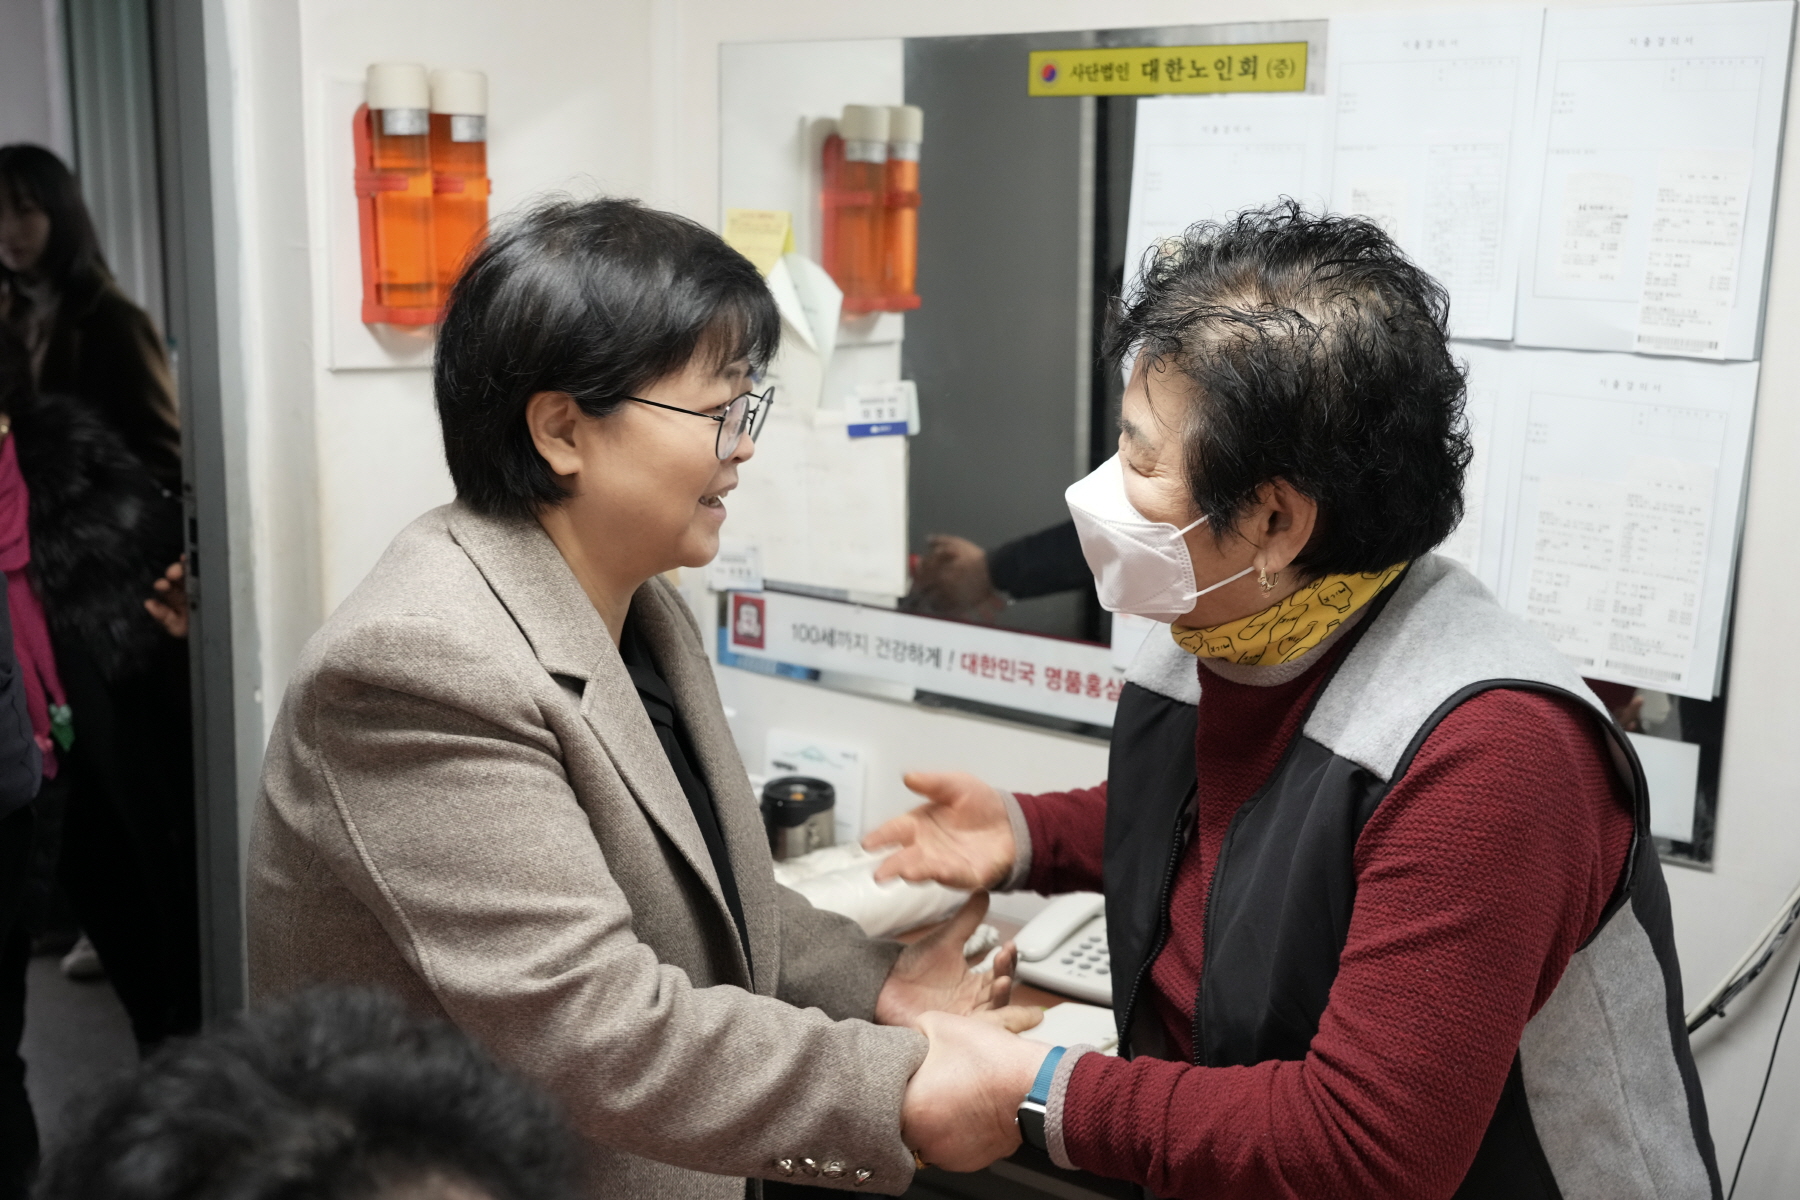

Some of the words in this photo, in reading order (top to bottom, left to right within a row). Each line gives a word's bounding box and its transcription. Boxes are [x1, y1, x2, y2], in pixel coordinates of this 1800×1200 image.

[1070, 61, 1130, 82] 사단법인
[1141, 55, 1258, 83] 대한노인회
[791, 623, 869, 655] 100세까지
[876, 636, 942, 669] 건강하게
[961, 652, 1035, 686] 대한민국
[1045, 666, 1123, 702] 명품홍삼
